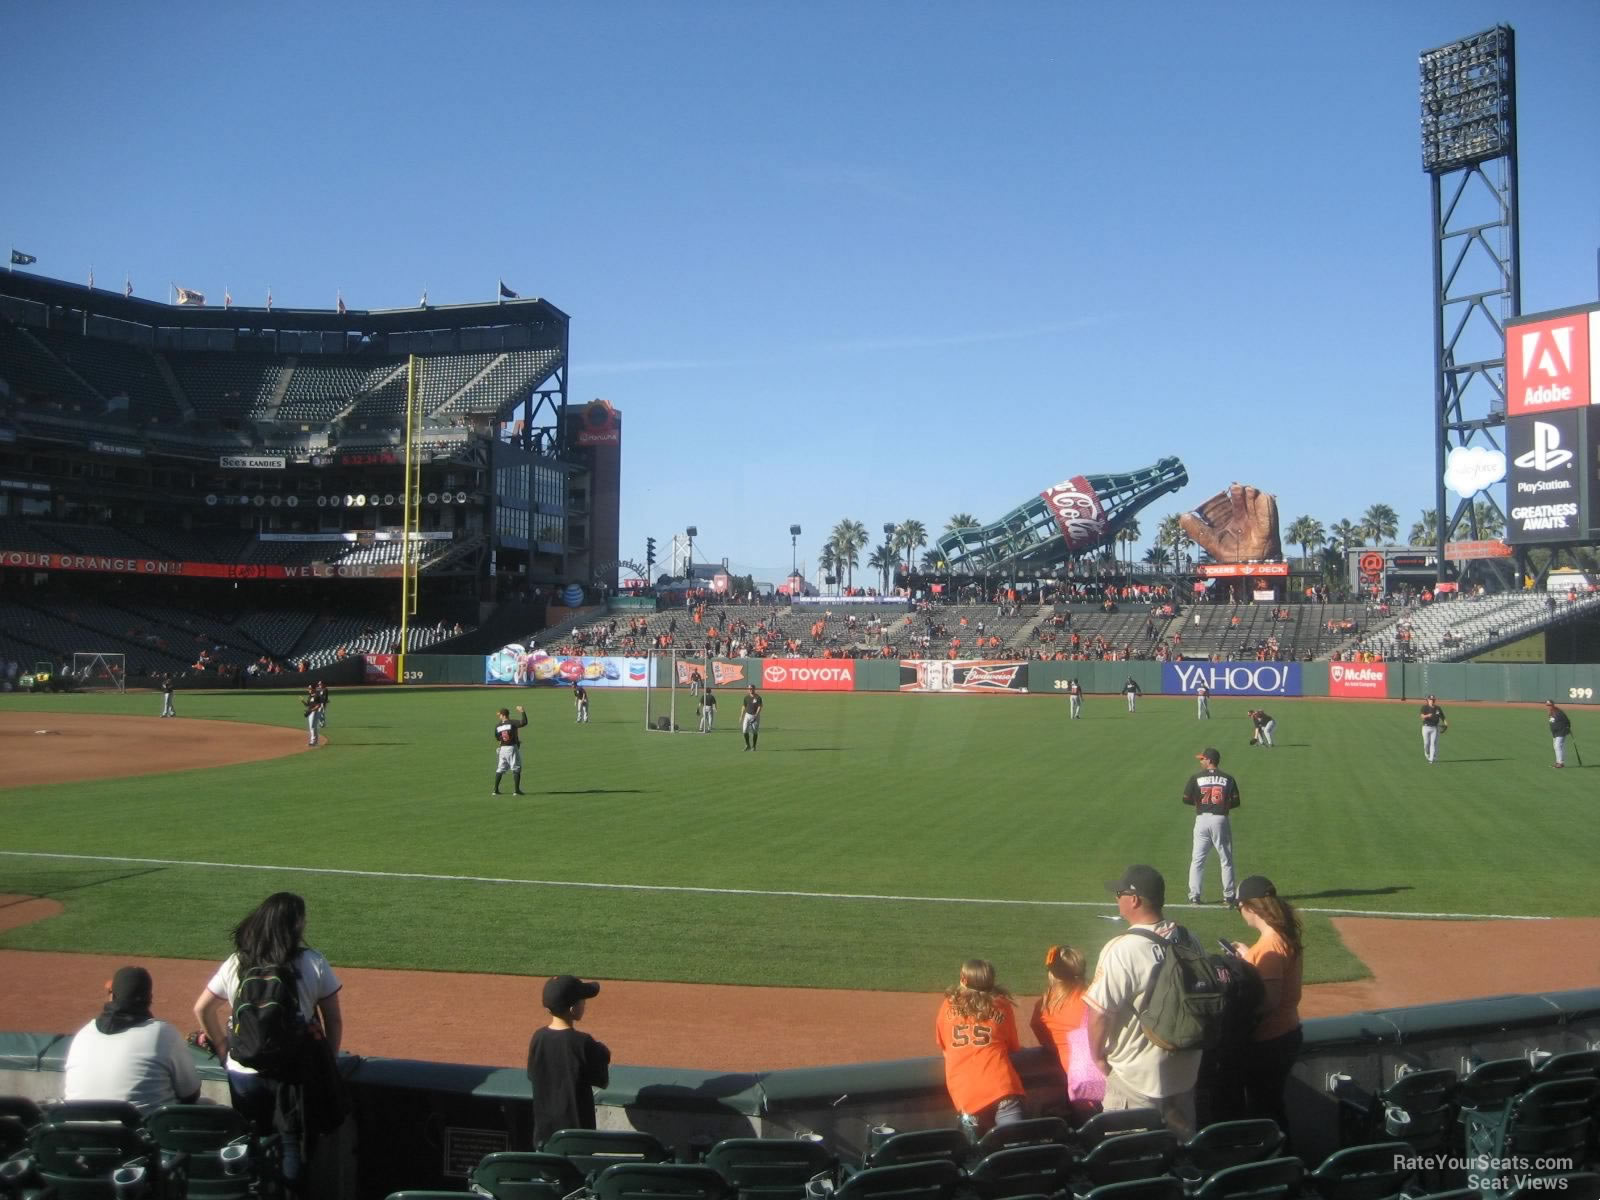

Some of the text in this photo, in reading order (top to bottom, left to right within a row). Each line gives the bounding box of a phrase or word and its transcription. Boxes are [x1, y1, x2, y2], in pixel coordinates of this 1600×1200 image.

[1524, 386, 1571, 406] Adobe
[249, 459, 282, 468] CANDIES
[1518, 480, 1570, 494] PlayStation
[1511, 503, 1577, 520] GREATNESS
[1522, 517, 1567, 531] AWAITS
[0, 553, 182, 574] YOUR ORANGE ON!!
[284, 566, 376, 577] WELCOME
[790, 668, 852, 681] TOYOTA
[963, 670, 1016, 681] Budweiser
[1174, 665, 1288, 692] YAHOO!
[1344, 669, 1383, 681] McAfee
[1054, 680, 1068, 689] 38
[1569, 688, 1593, 698] 399
[1200, 786, 1223, 804] 75
[952, 1024, 992, 1048] 55
